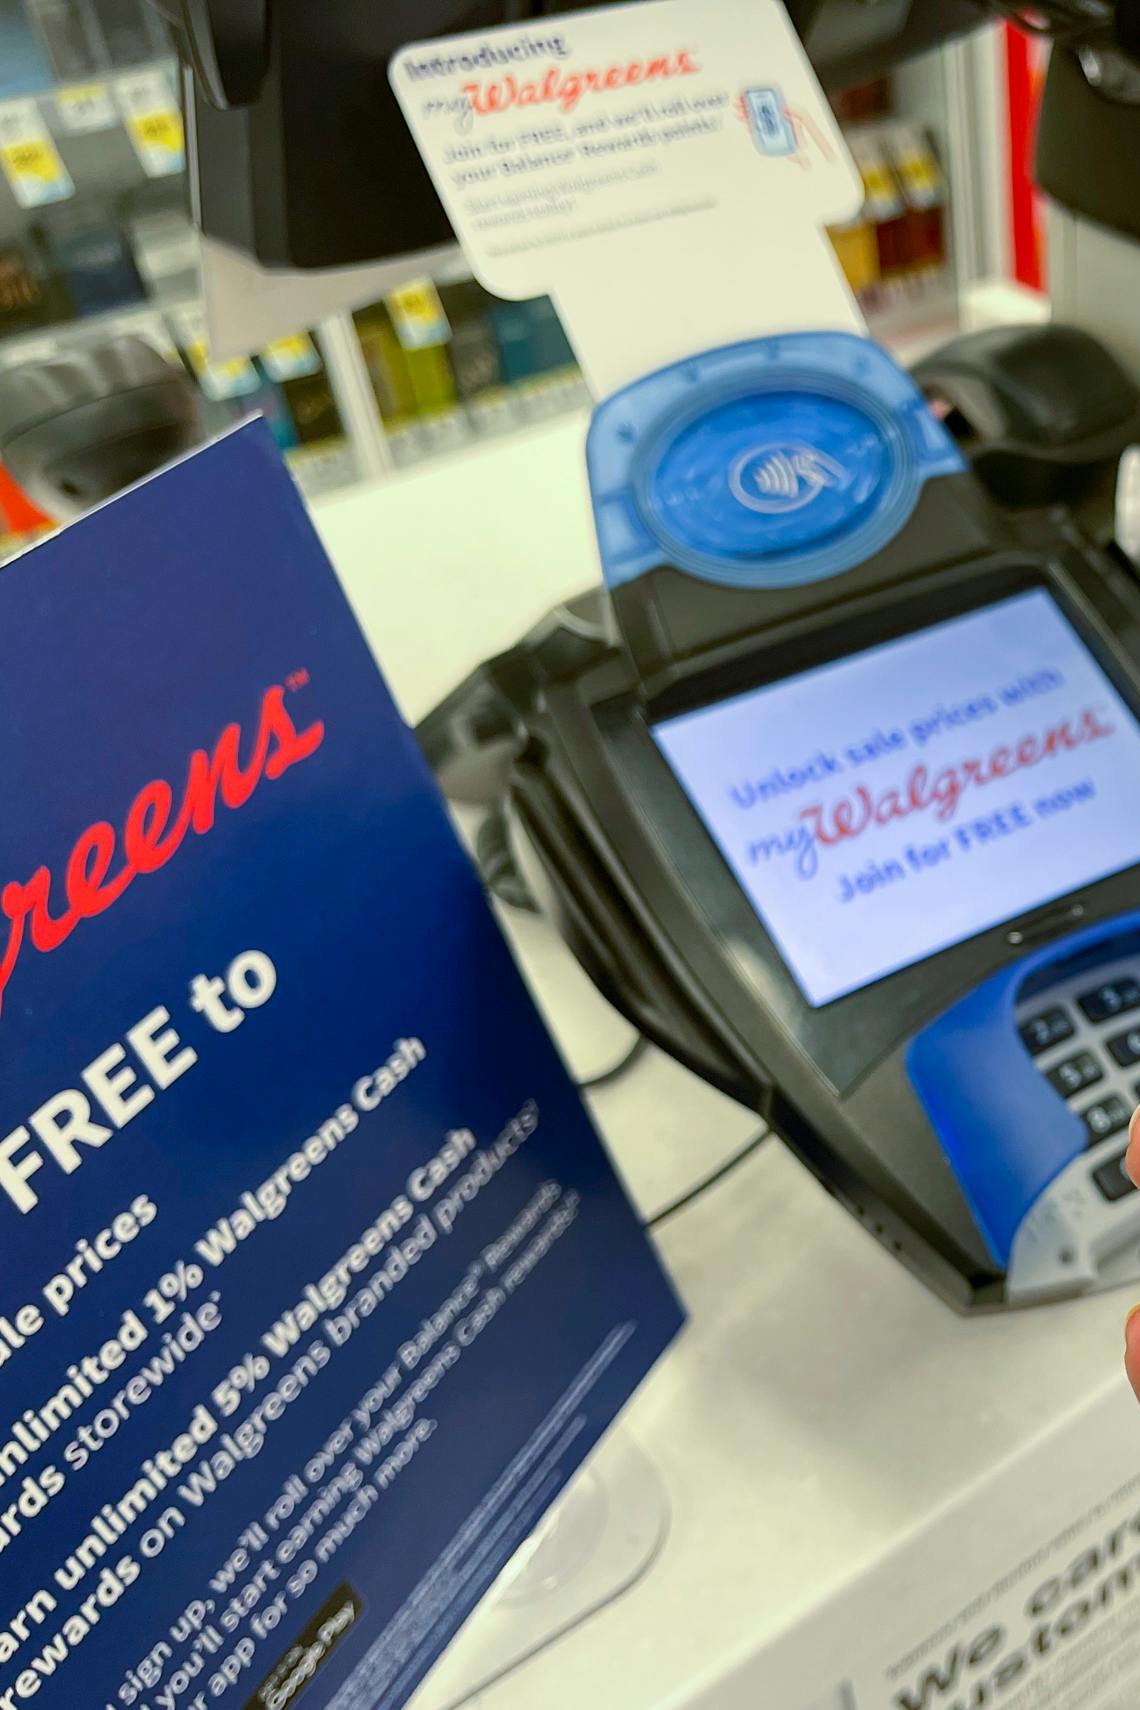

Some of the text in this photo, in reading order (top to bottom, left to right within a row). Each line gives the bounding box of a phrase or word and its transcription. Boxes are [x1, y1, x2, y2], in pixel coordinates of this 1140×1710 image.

[404, 34, 569, 82] Introducing
[730, 666, 1064, 809] Unlock sale prices with
[838, 777, 1097, 903] Join for FREE now
[0, 949, 277, 1214] FREE to
[0, 1036, 427, 1486] nlimited 1% Walgreens Cash
[42, 1194, 157, 1316] prices
[54, 1403, 218, 1591] unlimited
[211, 1352, 271, 1417] 5%
[261, 1195, 414, 1358] Walgreens
[406, 1127, 477, 1201] Cash
[0, 1555, 141, 1710] rewards
[139, 1506, 187, 1558] on
[177, 1339, 331, 1506] Walgreens
[324, 1213, 438, 1347] branded
[118, 1641, 173, 1705] sign
[169, 1599, 216, 1643] up,
[208, 1521, 270, 1593] we'll
[264, 1474, 309, 1531] roll
[303, 1417, 354, 1483] over
[350, 1360, 401, 1434] your
[220, 1559, 282, 1633] start
[275, 1462, 363, 1565] earning
[353, 1340, 462, 1465] Walgreens
[453, 1286, 507, 1347] Cash
[207, 1636, 256, 1697] app
[249, 1590, 288, 1640] for
[285, 1558, 319, 1599] so
[314, 1484, 380, 1564] much
[893, 1623, 1006, 1710] We
